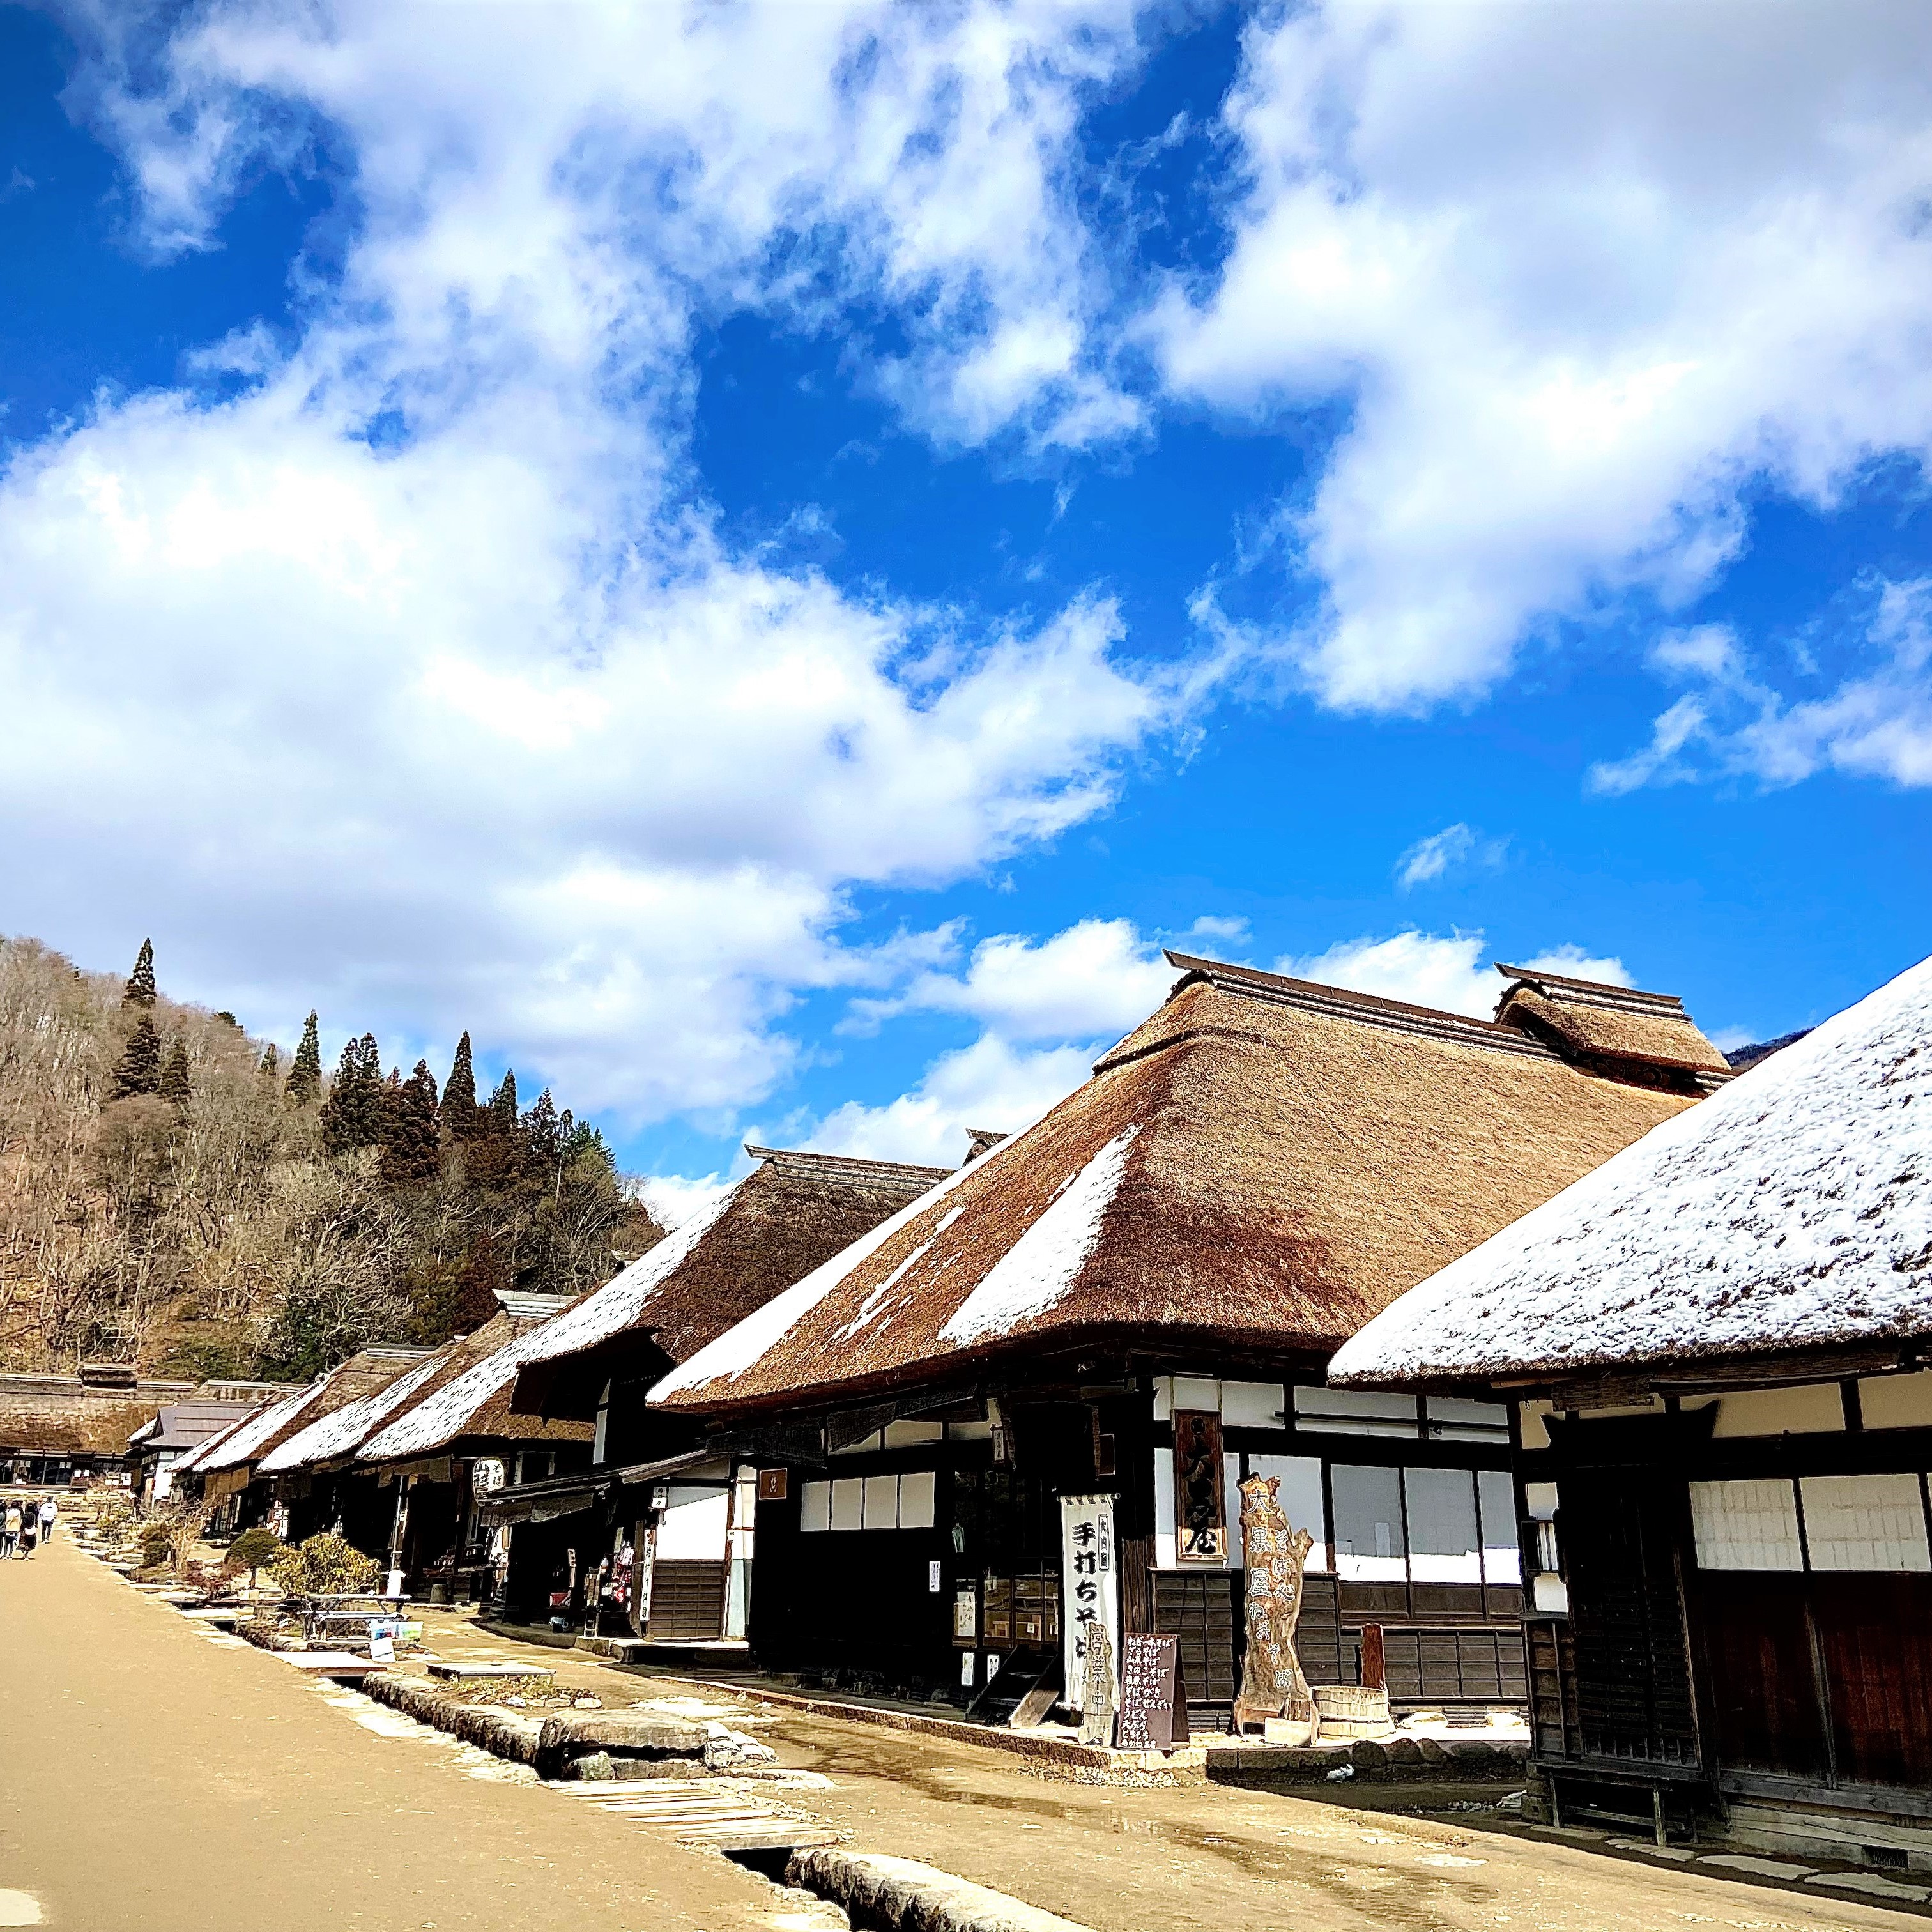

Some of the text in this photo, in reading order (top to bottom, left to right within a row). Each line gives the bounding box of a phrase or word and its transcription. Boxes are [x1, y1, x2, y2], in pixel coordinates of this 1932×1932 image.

[1248, 1489, 1271, 1597] 大黒屋
[1275, 1529, 1295, 1601] そばや
[1127, 1636, 1174, 1648] ねぎ一本そば
[1249, 1602, 1293, 1687] ねぎそば
[1126, 1664, 1170, 1678] きのこそば
[1126, 1685, 1162, 1699] そばがき
[1124, 1697, 1173, 1710] そばぜんざい
[1124, 1708, 1148, 1721] うどん
[1121, 1719, 1147, 1731] 天ぷら
[1122, 1729, 1149, 1741] とちもち
